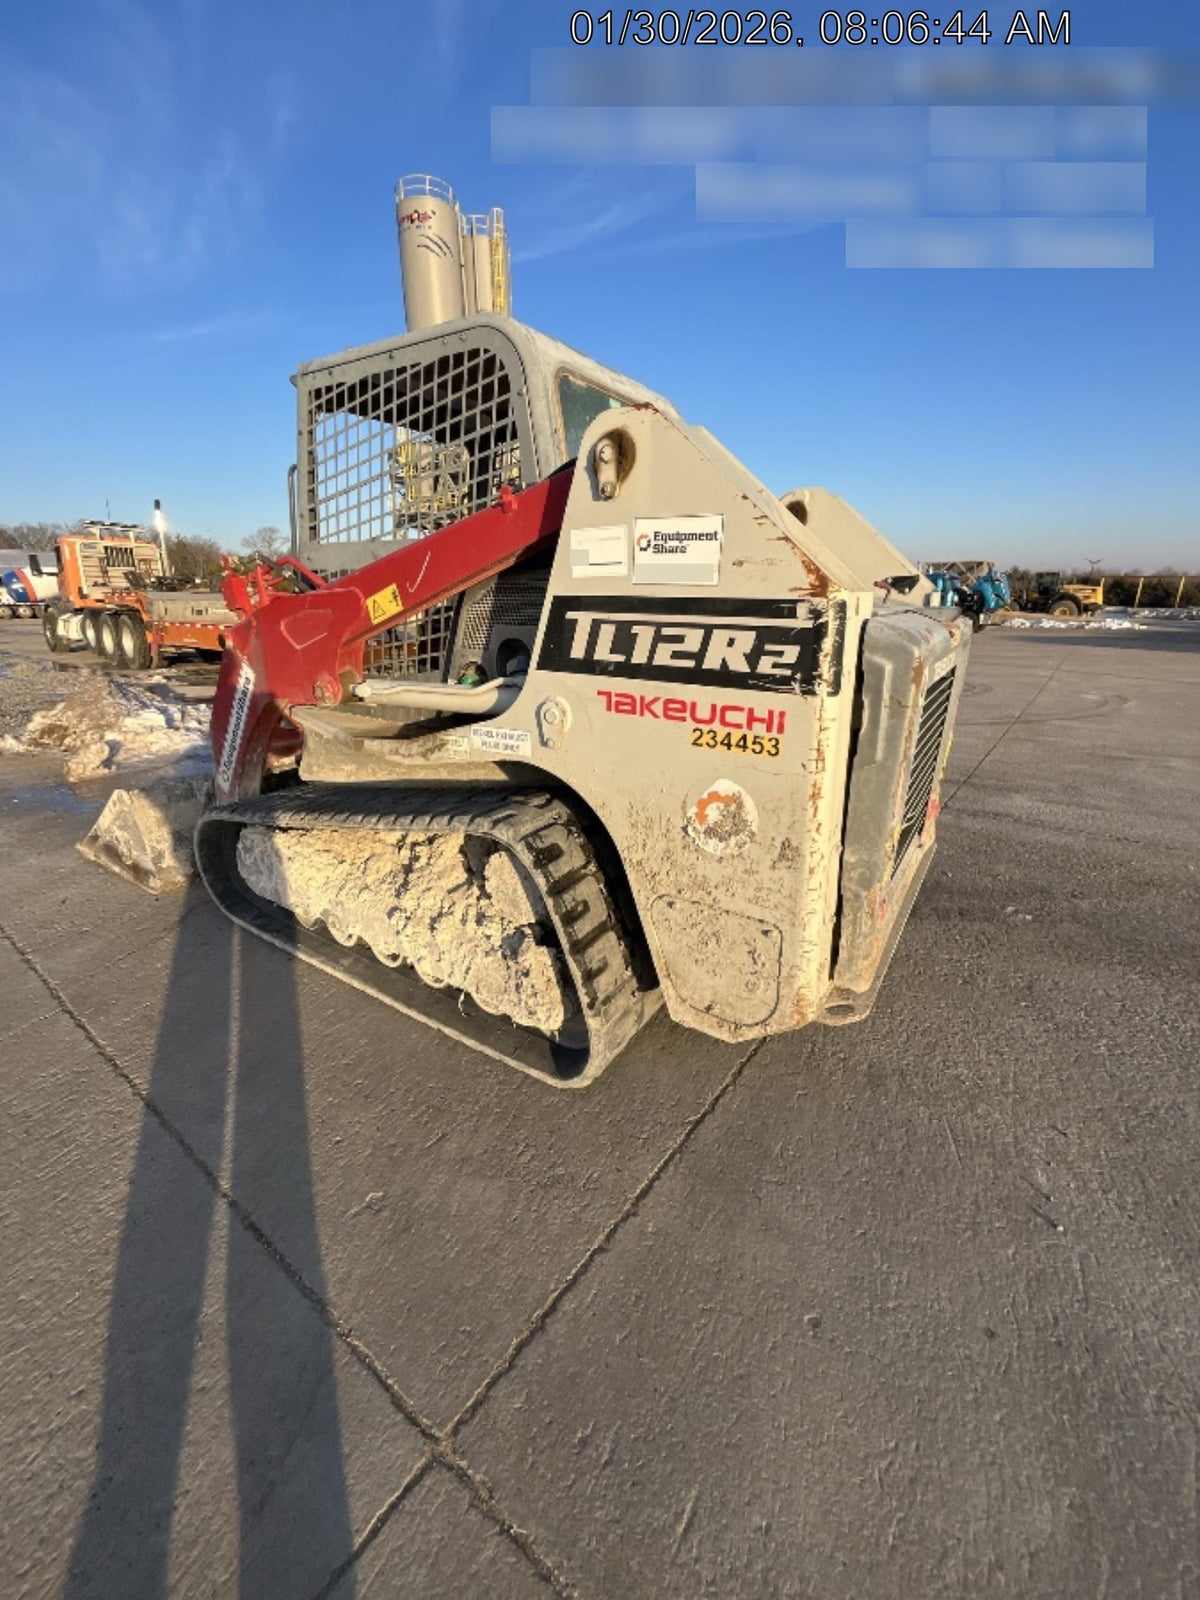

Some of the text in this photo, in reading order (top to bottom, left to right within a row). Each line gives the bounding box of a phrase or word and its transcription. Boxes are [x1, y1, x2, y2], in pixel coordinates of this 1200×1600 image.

[652, 543, 688, 554] Share
[653, 530, 719, 545] Equipment
[565, 611, 814, 675] TL12R2
[691, 728, 781, 757] 234453
